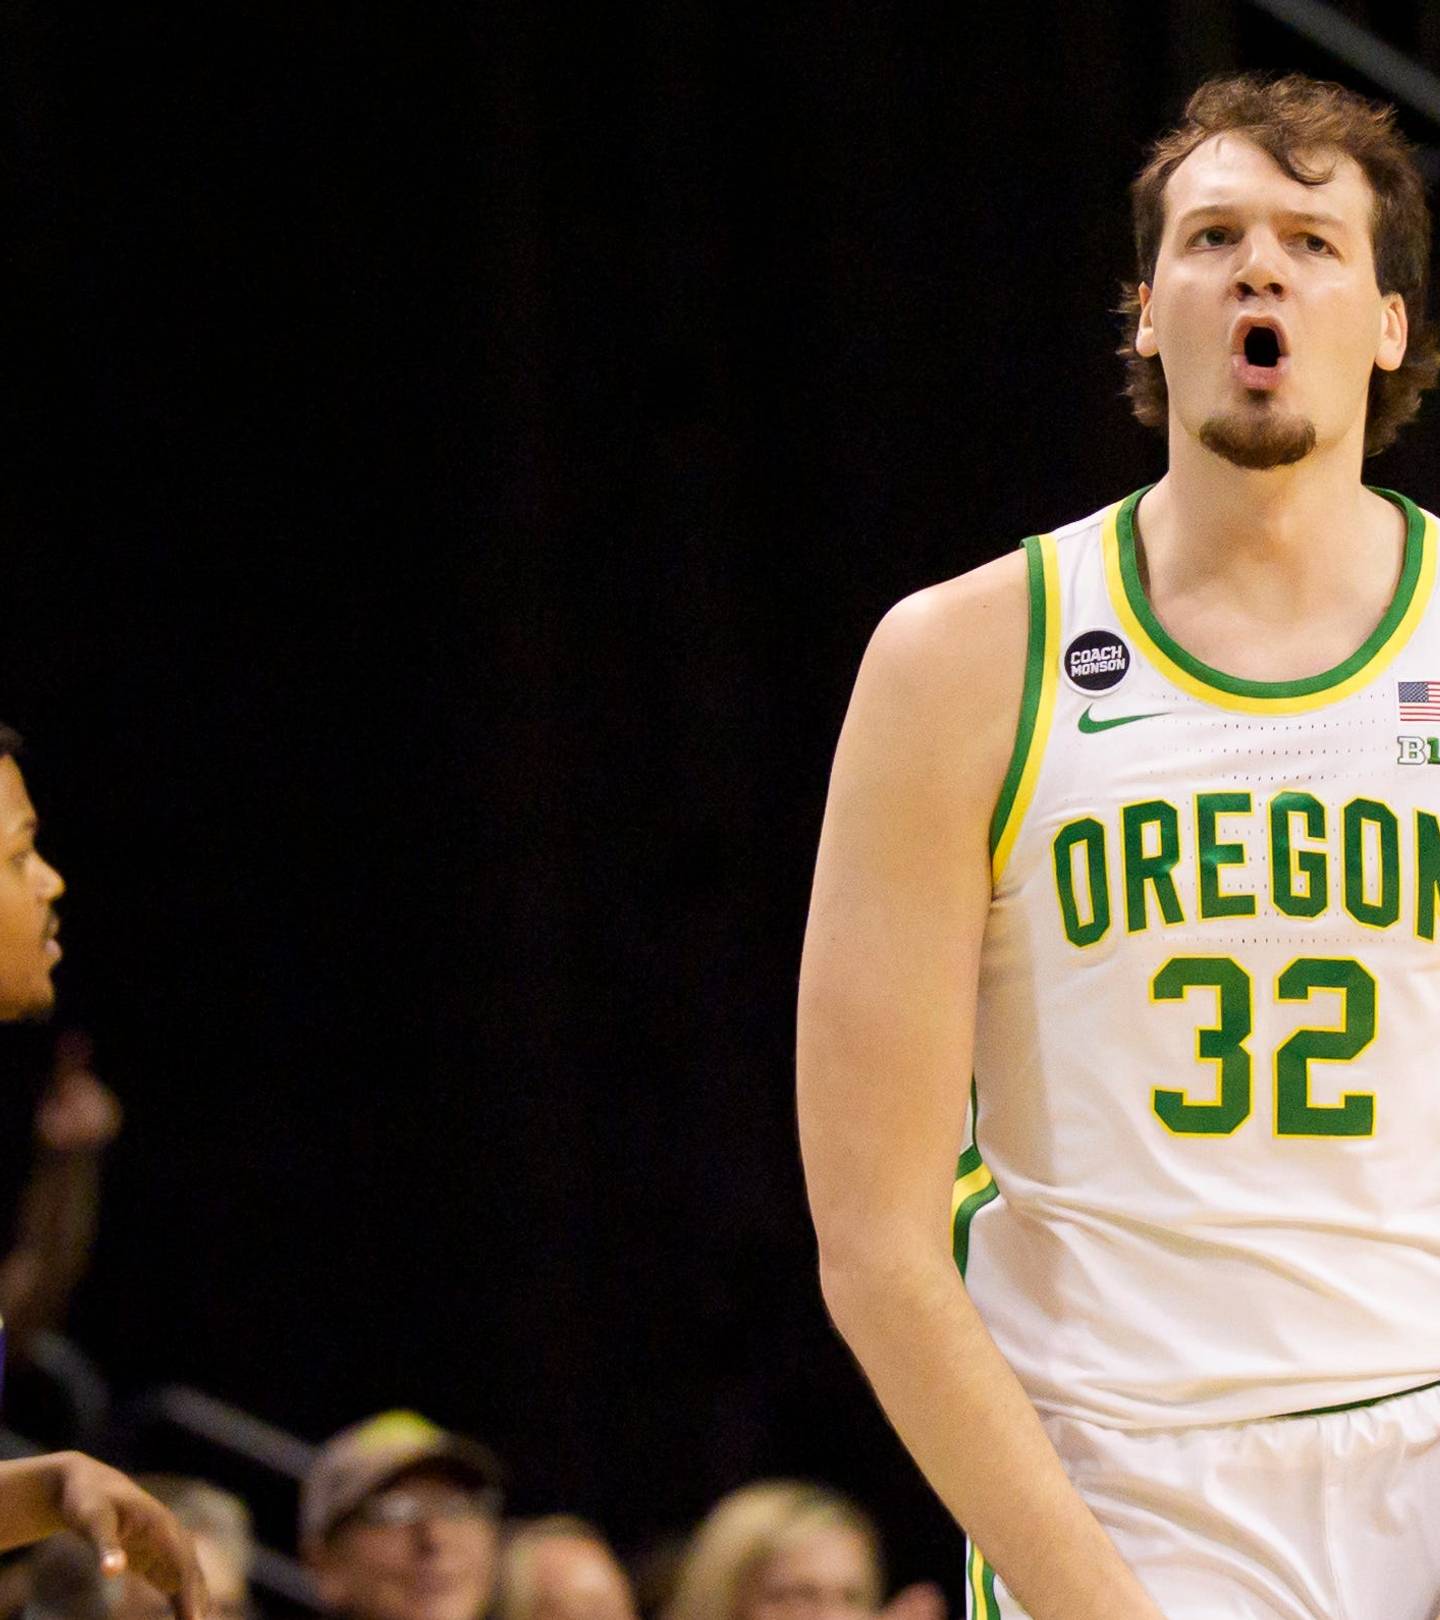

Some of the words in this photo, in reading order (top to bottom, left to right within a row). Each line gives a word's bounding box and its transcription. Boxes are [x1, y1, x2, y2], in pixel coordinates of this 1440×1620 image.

[1070, 645, 1122, 664] COACH
[1070, 659, 1126, 677] MONSON
[1150, 955, 1378, 1137] 32
